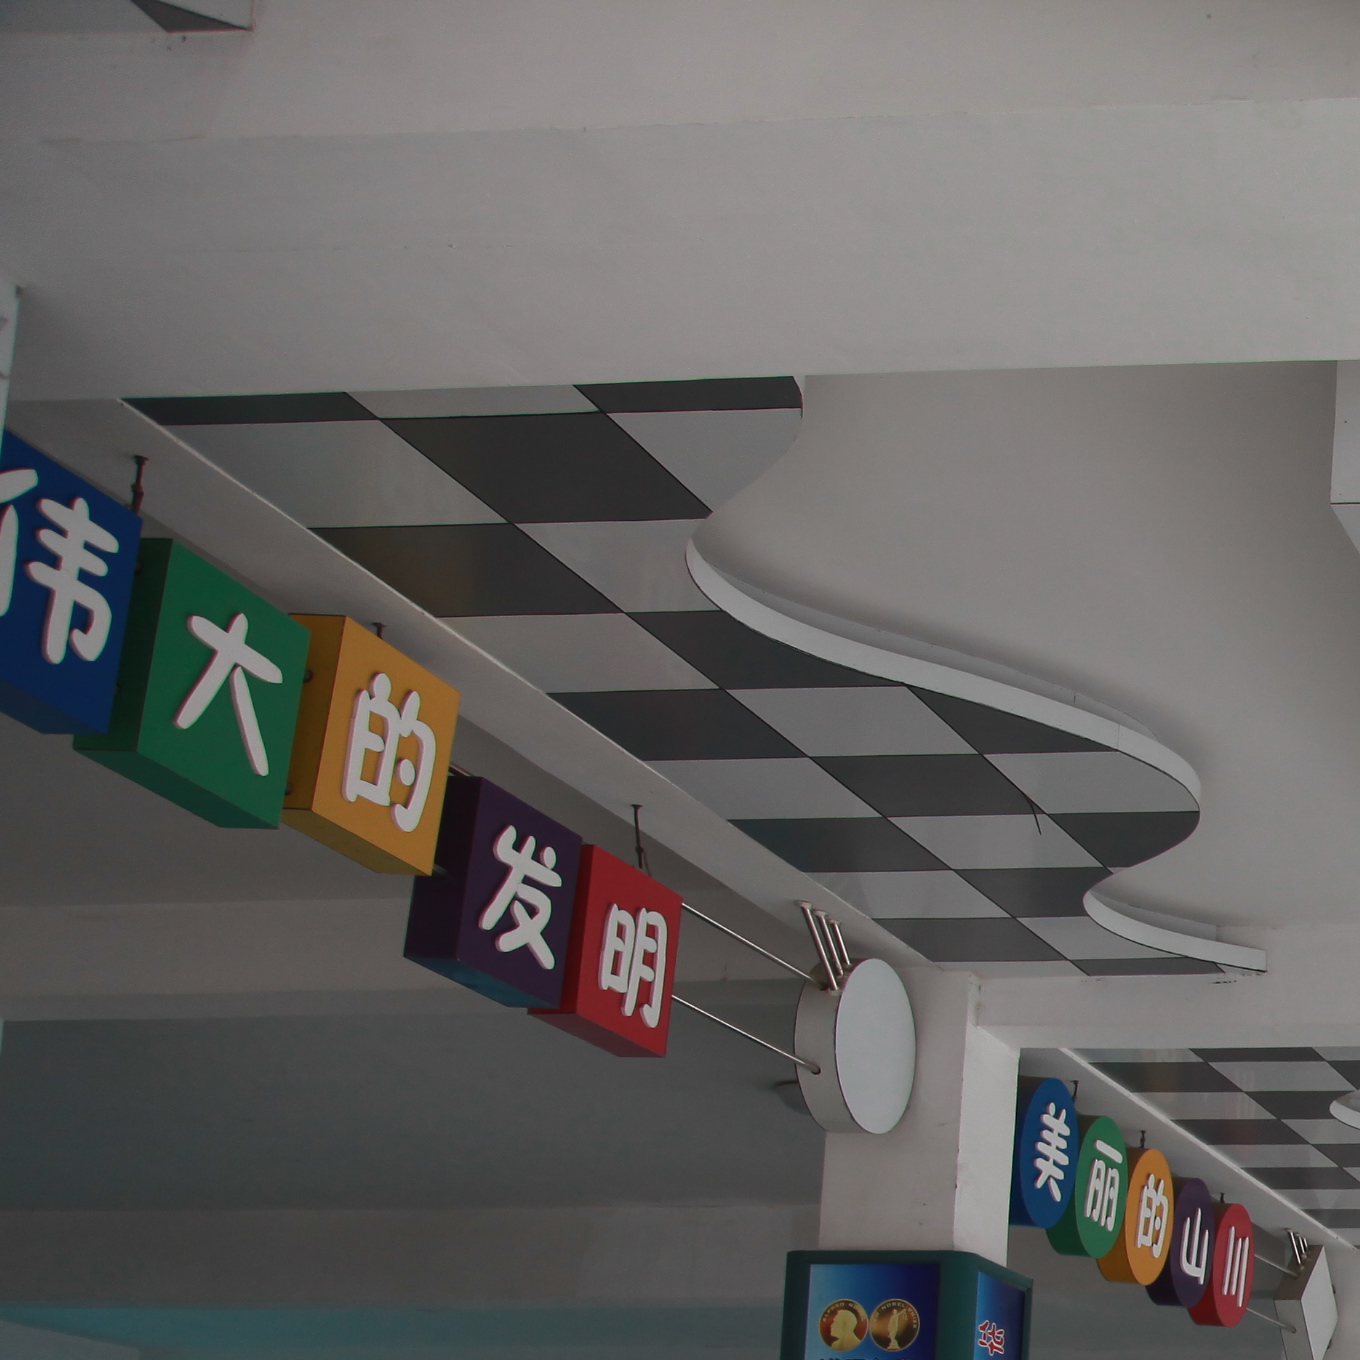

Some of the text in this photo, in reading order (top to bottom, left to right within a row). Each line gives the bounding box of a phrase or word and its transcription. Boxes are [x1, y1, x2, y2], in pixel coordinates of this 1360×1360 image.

[1034, 1102, 1249, 1307] 美丽的山川
